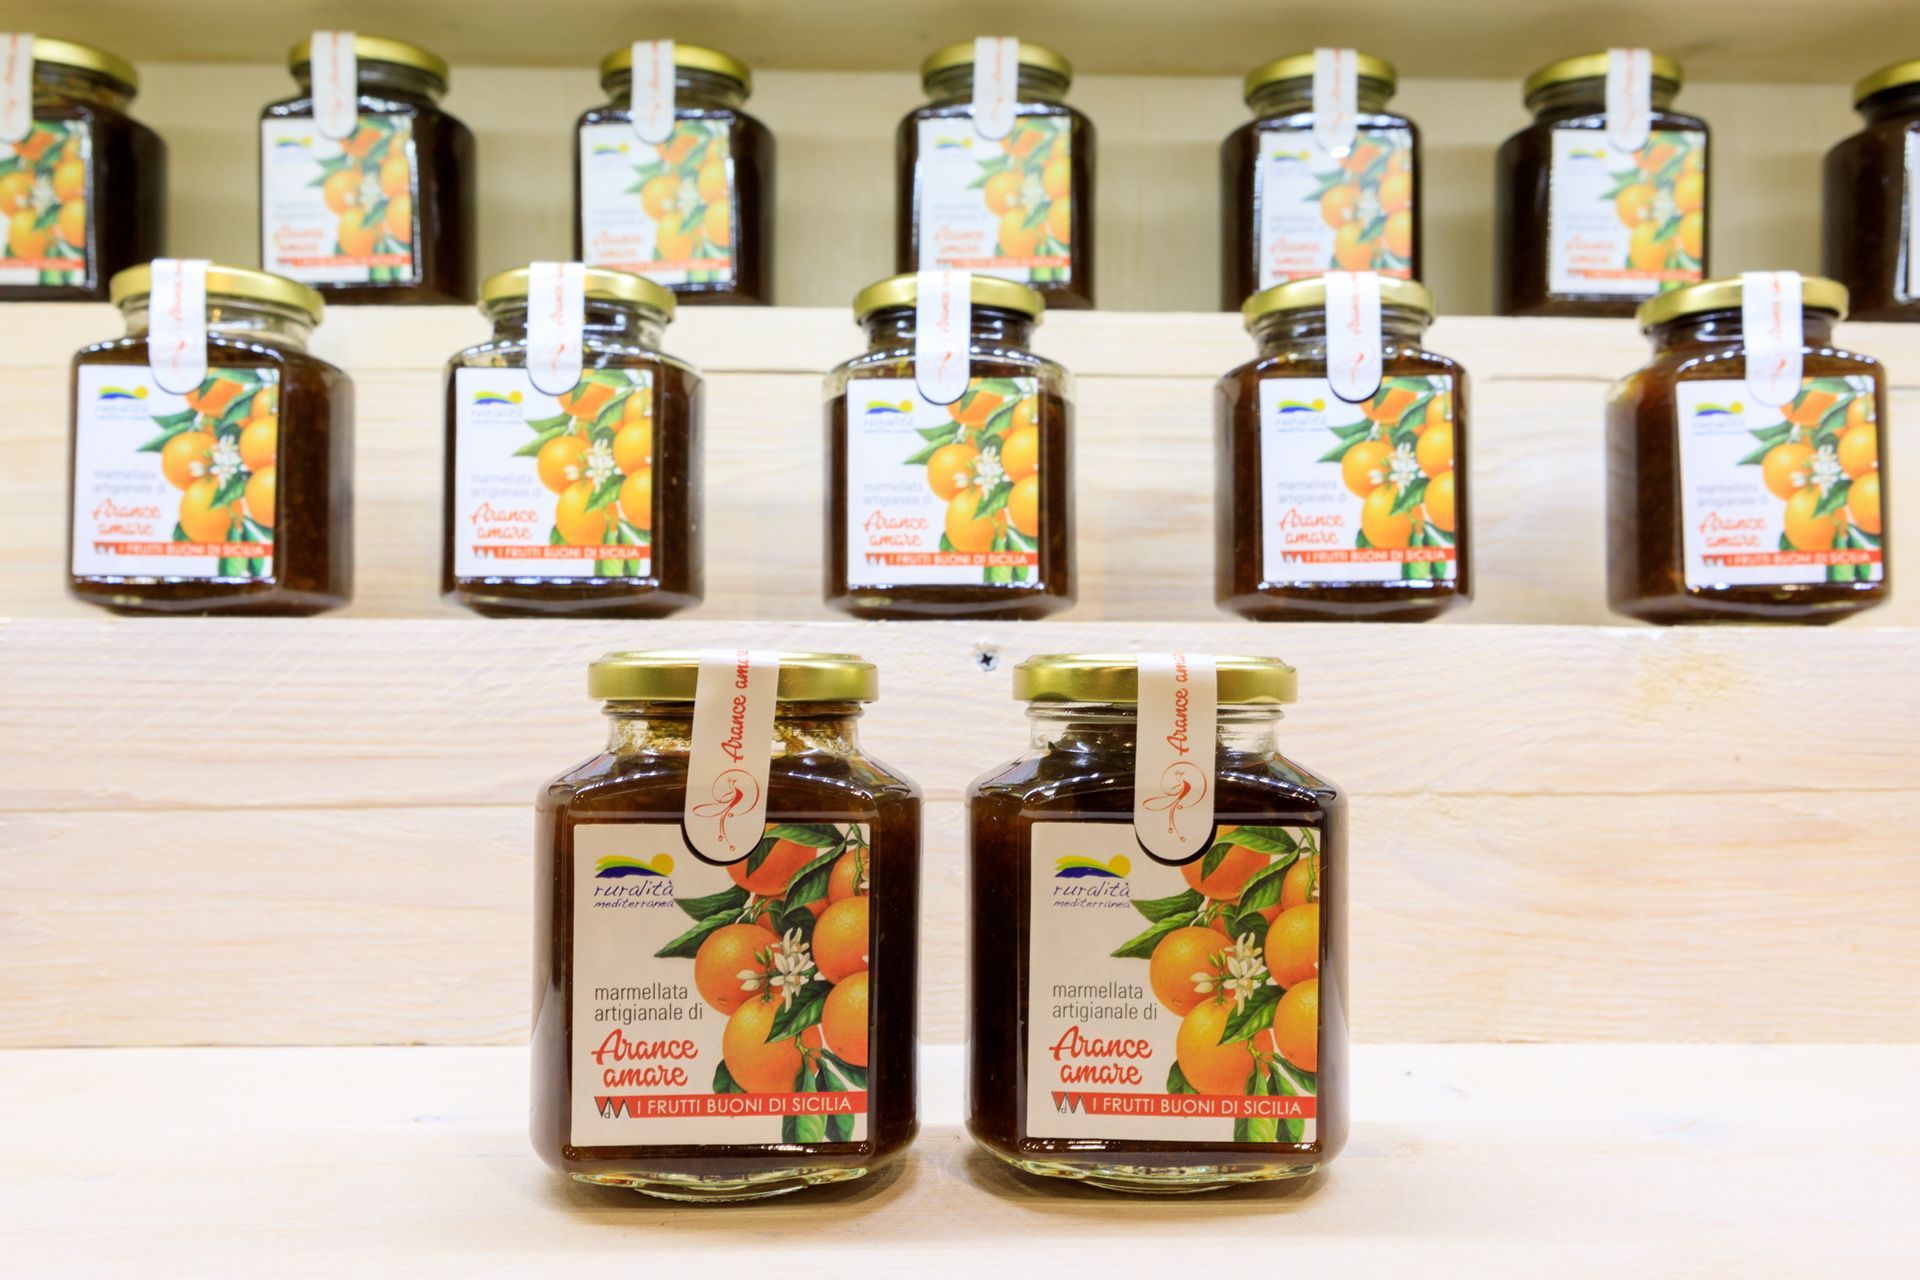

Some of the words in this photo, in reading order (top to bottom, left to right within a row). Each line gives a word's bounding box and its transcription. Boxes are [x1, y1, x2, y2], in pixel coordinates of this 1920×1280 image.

[720, 695, 746, 763] Arance
[1166, 688, 1190, 756] Arance
[593, 880, 674, 897] ruralità
[1053, 881, 1130, 897] ruralità
[594, 899, 674, 908] mediterranea
[1053, 899, 1130, 908] mediterranea
[594, 982, 688, 1001] marmellata
[1052, 981, 1143, 999] marmellata
[594, 1003, 683, 1025] artigianale
[688, 1003, 703, 1020] di
[1052, 1001, 1138, 1023] artigianale
[1143, 1002, 1157, 1020] di
[591, 1028, 698, 1065] Arance
[1048, 1025, 1153, 1061] Arance
[603, 1064, 689, 1088] amare
[1060, 1062, 1143, 1085] amare
[637, 1101, 641, 1115] I
[647, 1099, 700, 1114] FRUTTI
[706, 1098, 762, 1113] BUONI
[769, 1098, 786, 1112] DI
[791, 1096, 853, 1112] SICILIA
[1092, 1098, 1097, 1111] I
[1103, 1097, 1155, 1113] FRUTTI
[1160, 1099, 1214, 1114] BUONI
[1221, 1100, 1238, 1114] DI
[1243, 1100, 1303, 1116] SICILIA
